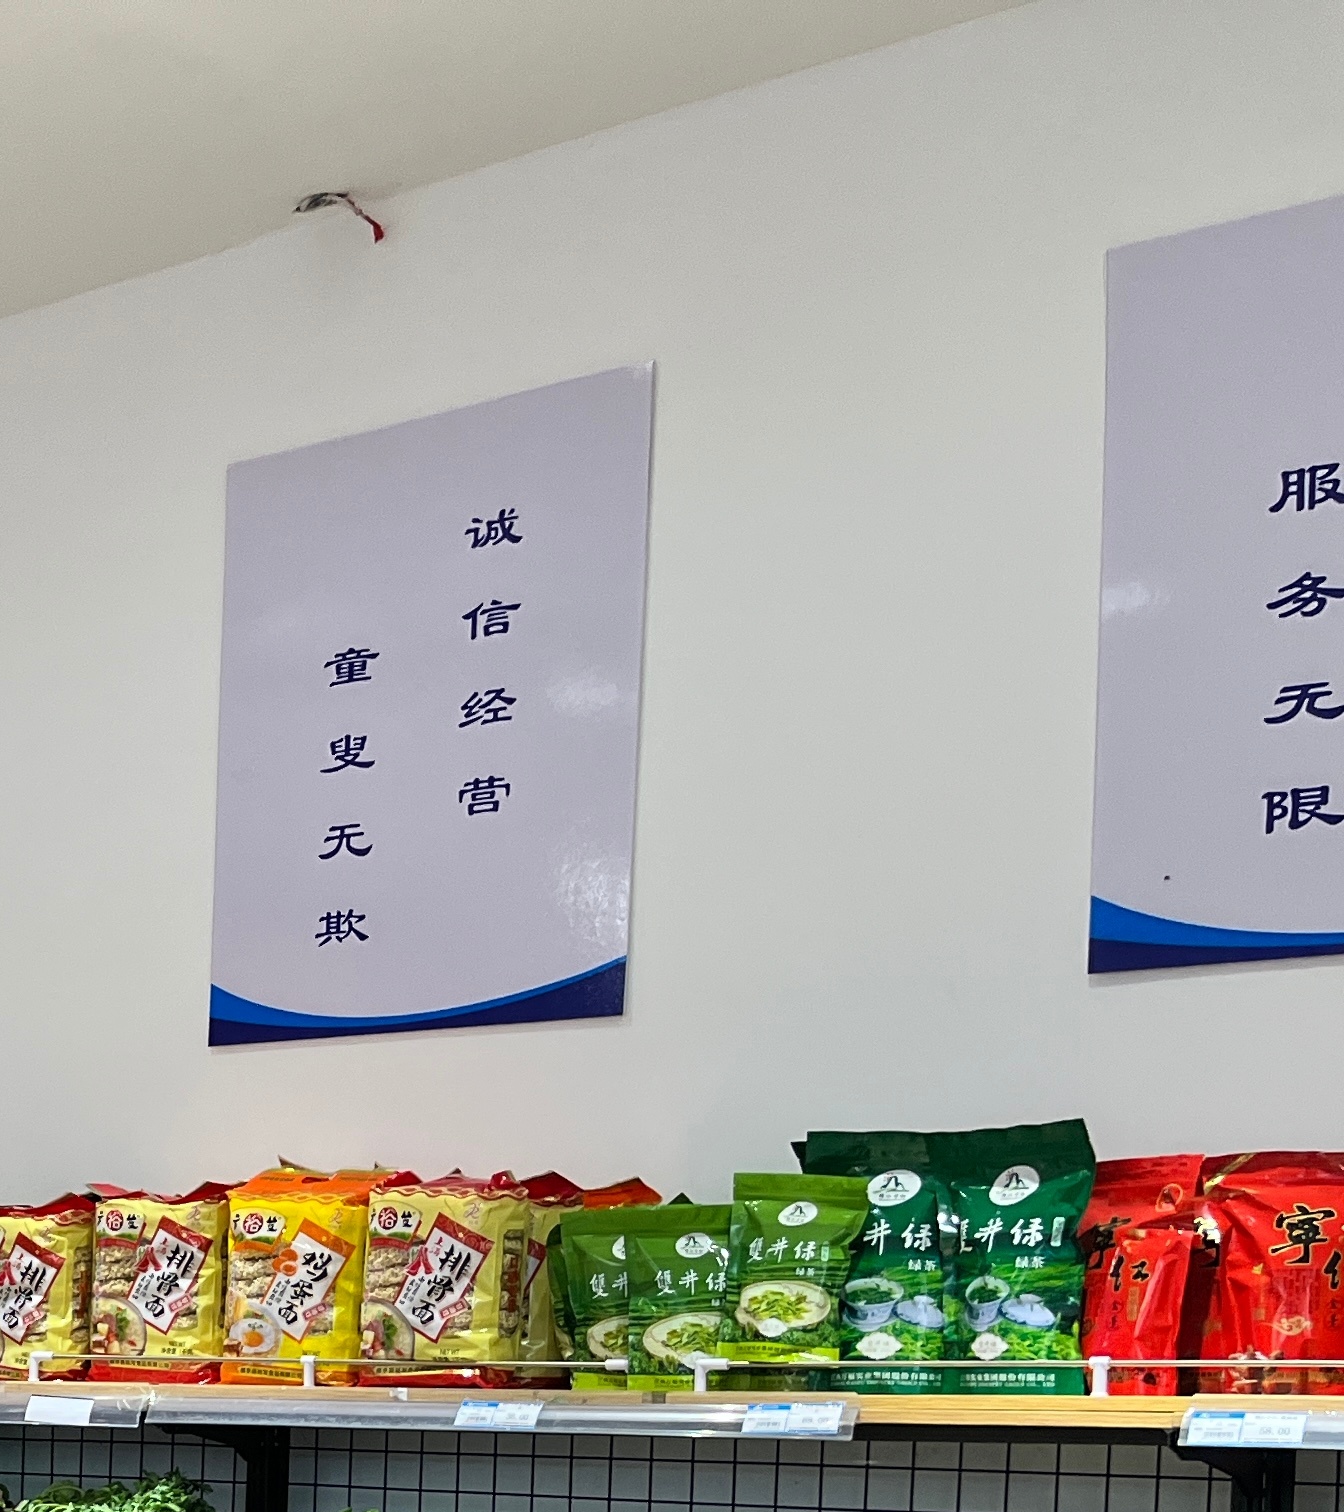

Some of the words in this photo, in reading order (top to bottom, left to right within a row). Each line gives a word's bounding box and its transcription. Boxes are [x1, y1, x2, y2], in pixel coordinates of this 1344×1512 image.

[457, 507, 523, 817] 诚信经营
[1261, 462, 1344, 834] 服务无限
[314, 647, 380, 948] 童叟无欺
[3, 1261, 46, 1329] 排骨面
[145, 1244, 194, 1317] 排骨面
[412, 1244, 472, 1325] 排骨面
